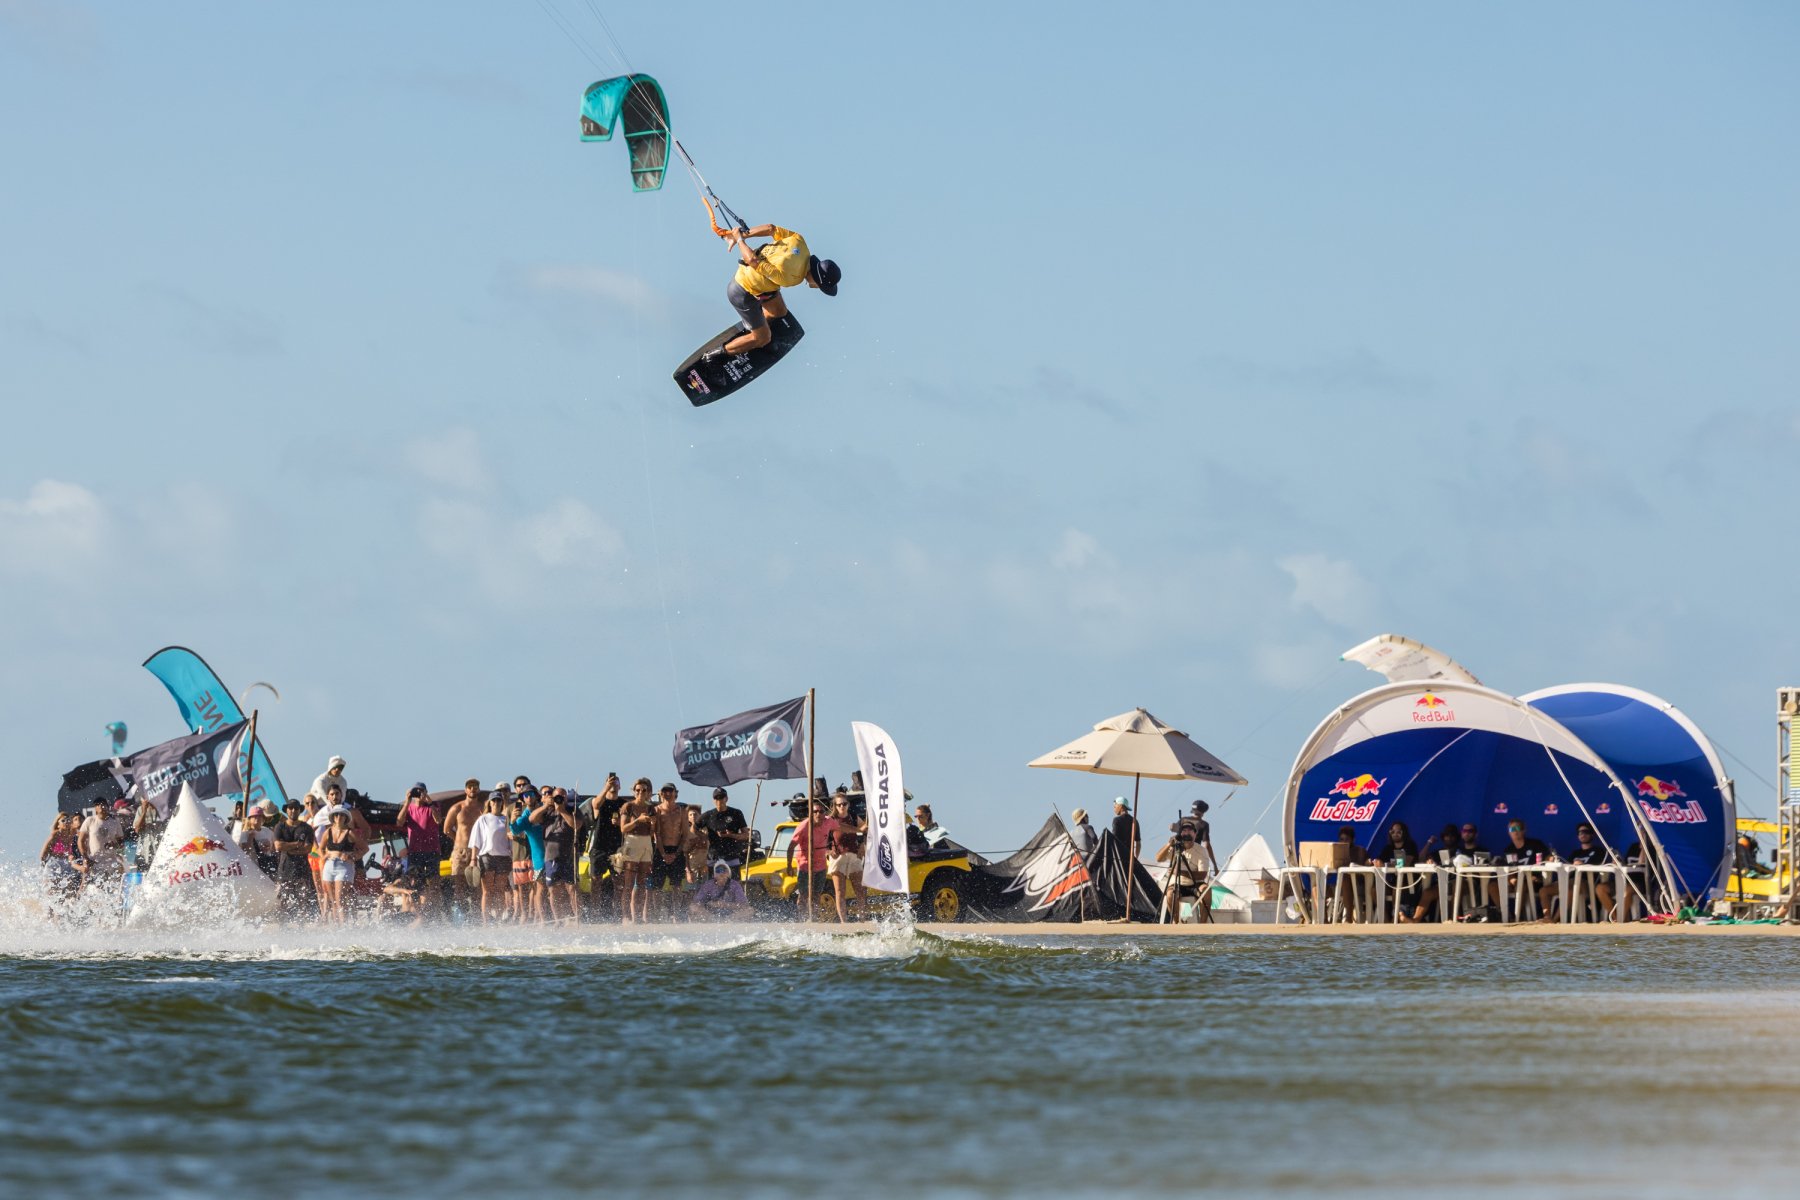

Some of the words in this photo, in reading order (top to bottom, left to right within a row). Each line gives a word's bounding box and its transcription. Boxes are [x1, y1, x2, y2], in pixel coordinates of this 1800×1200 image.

[1412, 711, 1433, 722] Red
[1434, 709, 1455, 722] Bull
[874, 743, 889, 829] CRASA
[1667, 801, 1707, 823] Bull
[881, 842, 894, 871] Ford
[169, 866, 205, 887] Red
